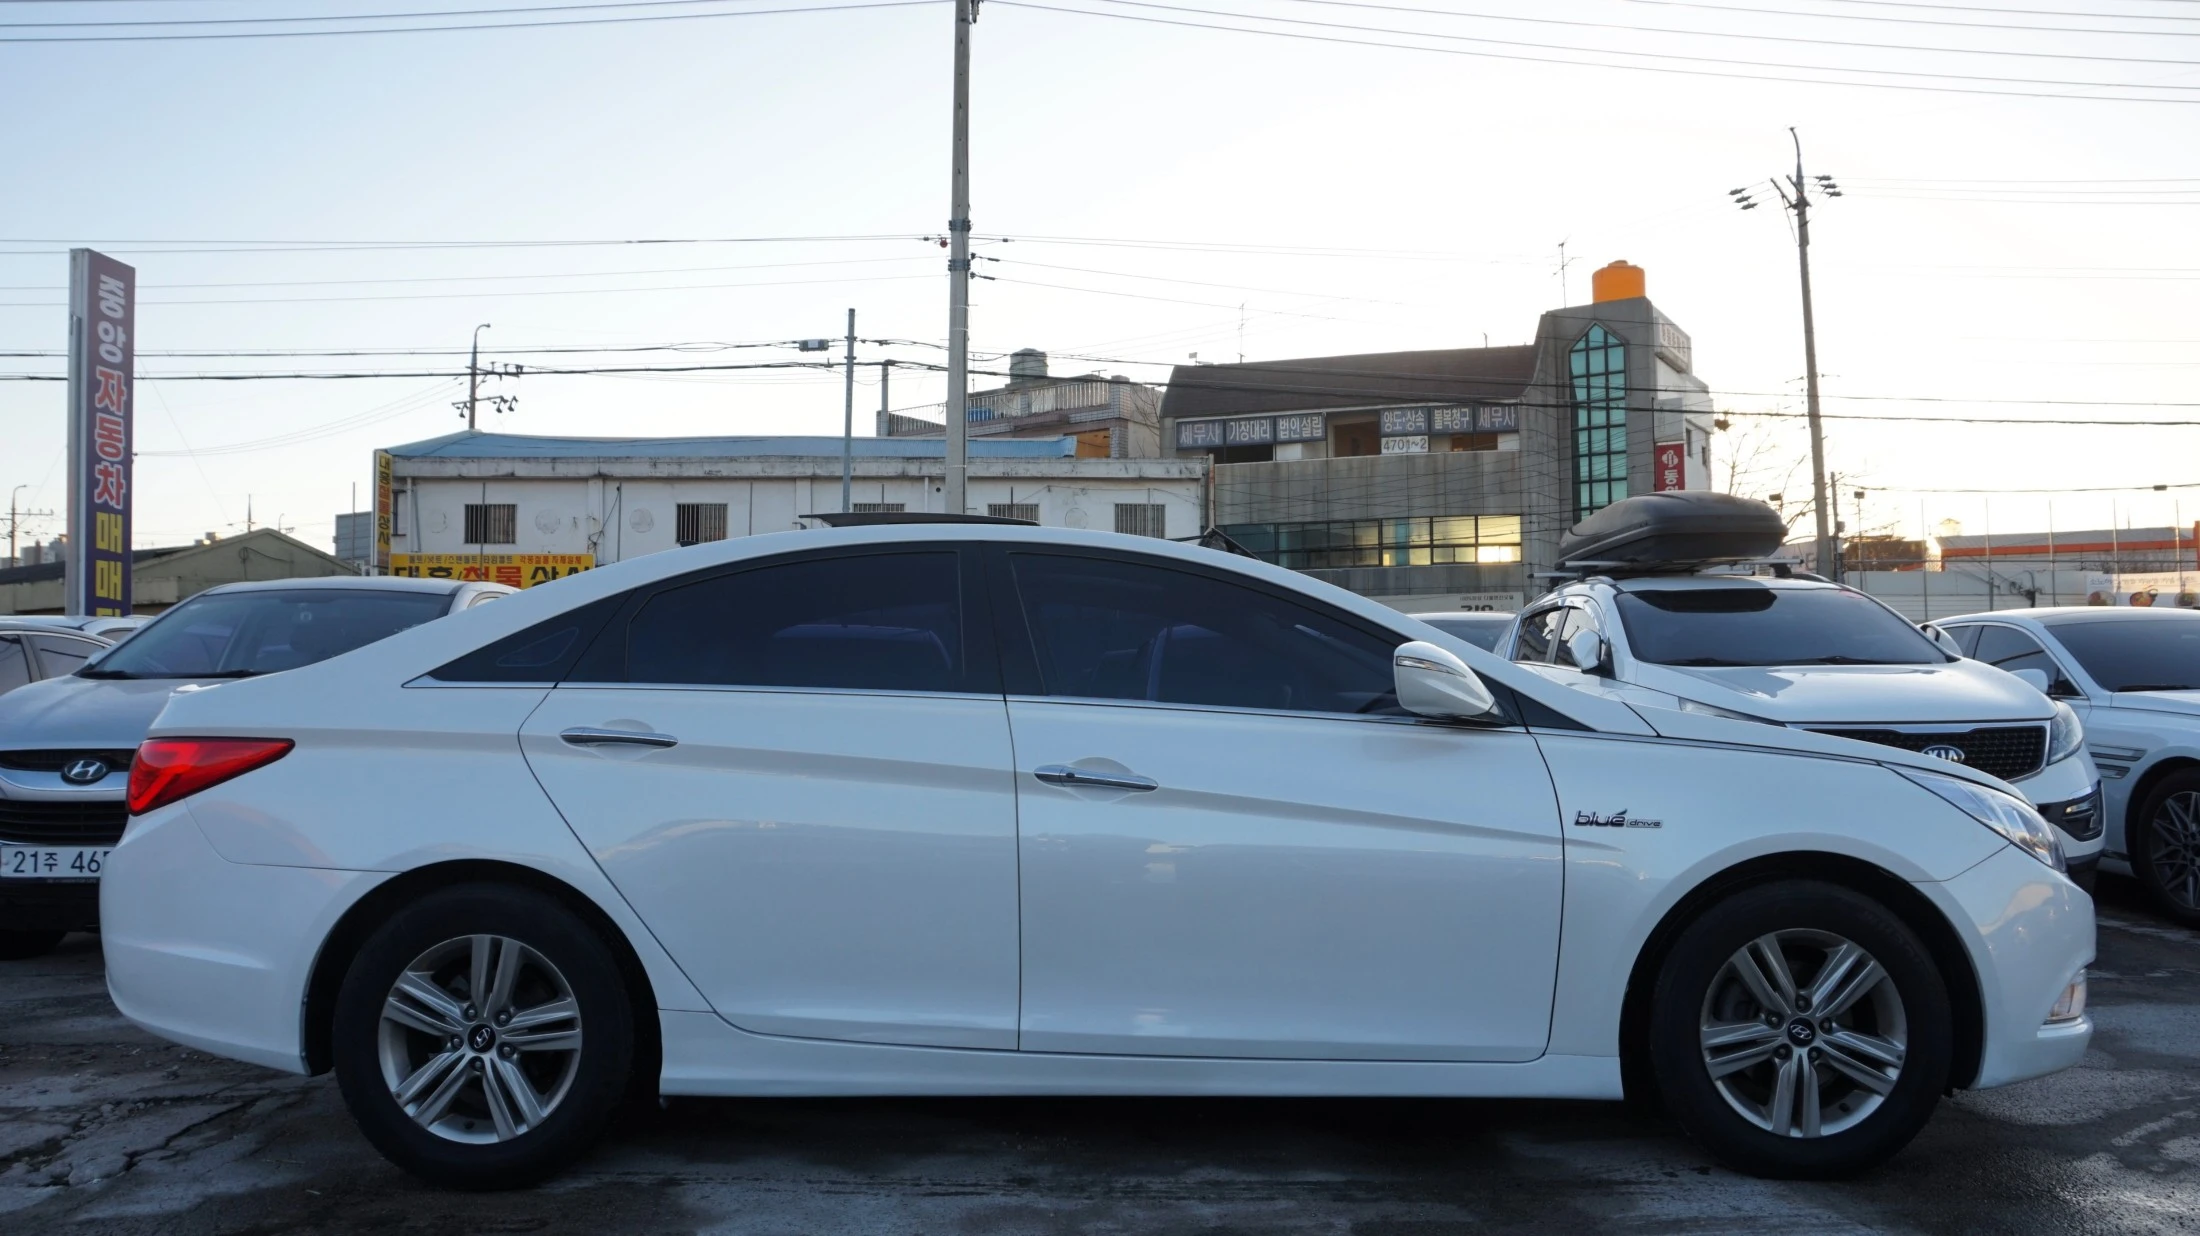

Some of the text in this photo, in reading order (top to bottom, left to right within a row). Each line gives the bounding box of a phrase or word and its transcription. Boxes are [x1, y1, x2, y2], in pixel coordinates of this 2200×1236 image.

[1434, 407, 1470, 429] 불복청구
[1478, 406, 1516, 428] 세무사
[1180, 416, 1322, 445] 세무사 기장대리 법인설립
[94, 273, 127, 616] 중앙자동차매매
[1383, 438, 1428, 451] 4701~2
[1663, 469, 1679, 491] 동
[1629, 819, 1662, 828] drive
[13, 850, 111, 873] 21주 46
